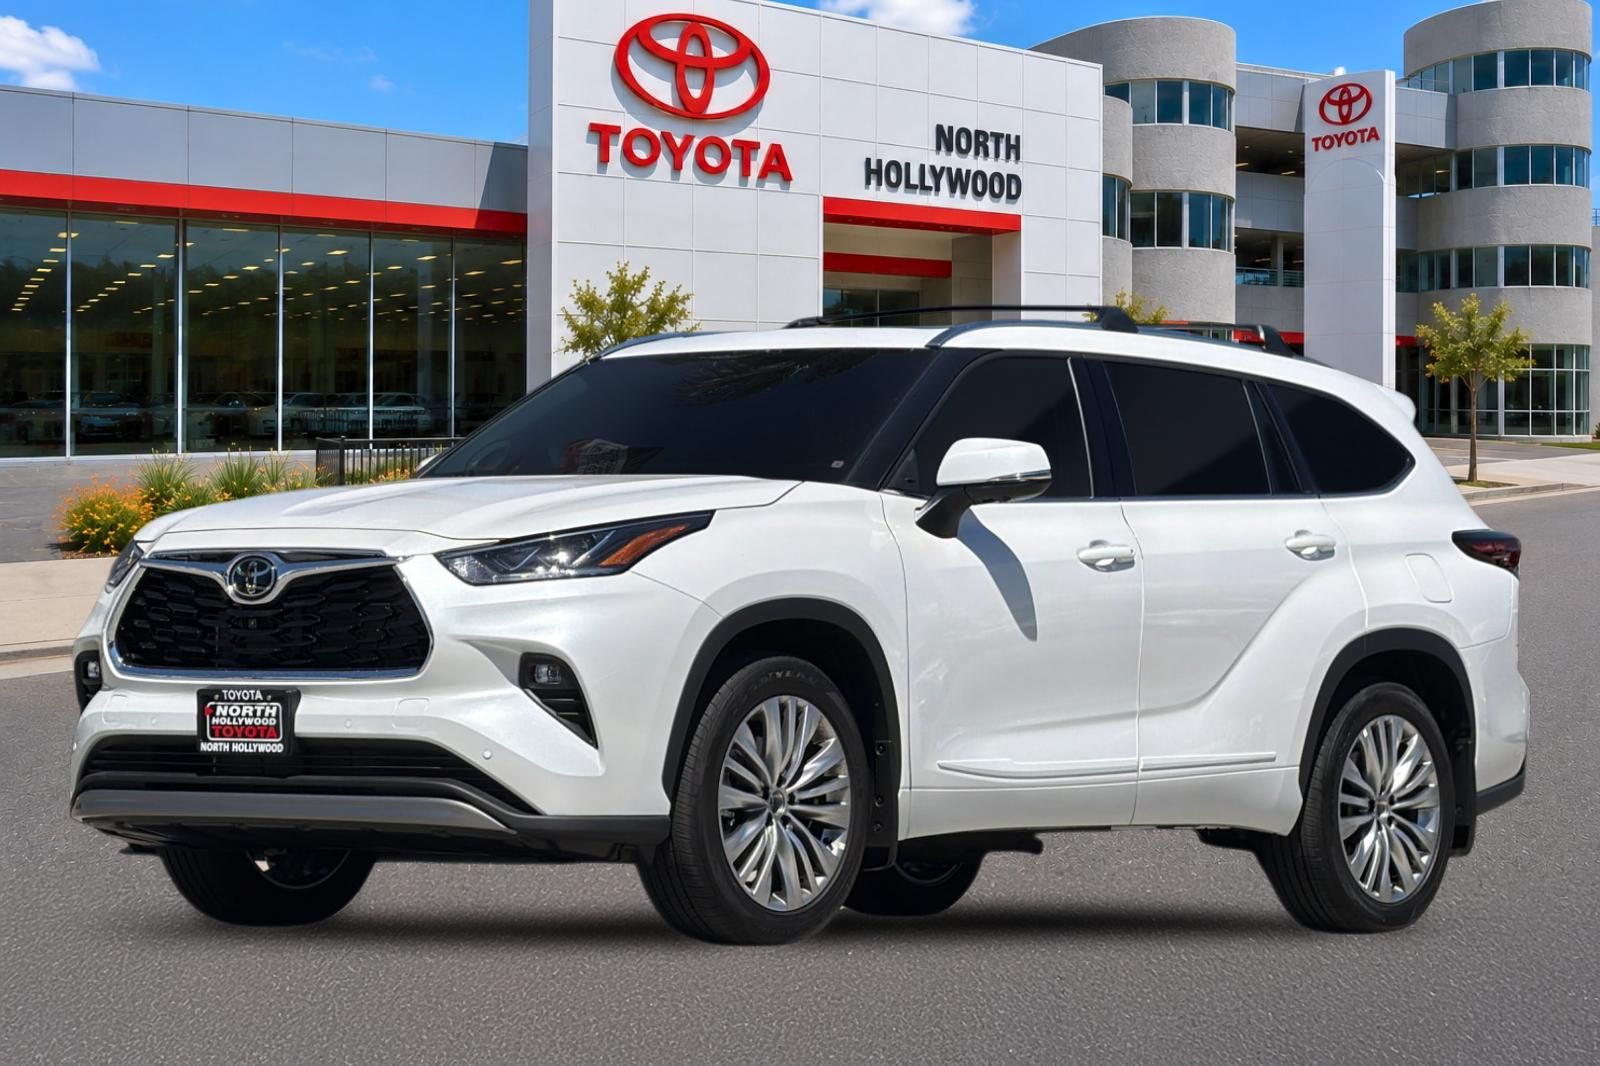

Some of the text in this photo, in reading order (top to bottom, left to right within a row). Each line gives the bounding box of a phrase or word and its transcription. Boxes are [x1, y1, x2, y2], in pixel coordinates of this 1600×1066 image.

[935, 124, 1021, 161] NORTH
[1311, 126, 1380, 152] TOYOTA
[588, 122, 793, 182] TOYOTA
[864, 157, 1022, 201] HOLLYWOOD
[222, 690, 263, 701] TOYOTA
[215, 705, 277, 717] NORTH
[211, 717, 277, 726] HOLLYWOOD
[211, 726, 278, 738] TOYOTA
[200, 742, 284, 753] NORTH HOLLYWOOD
